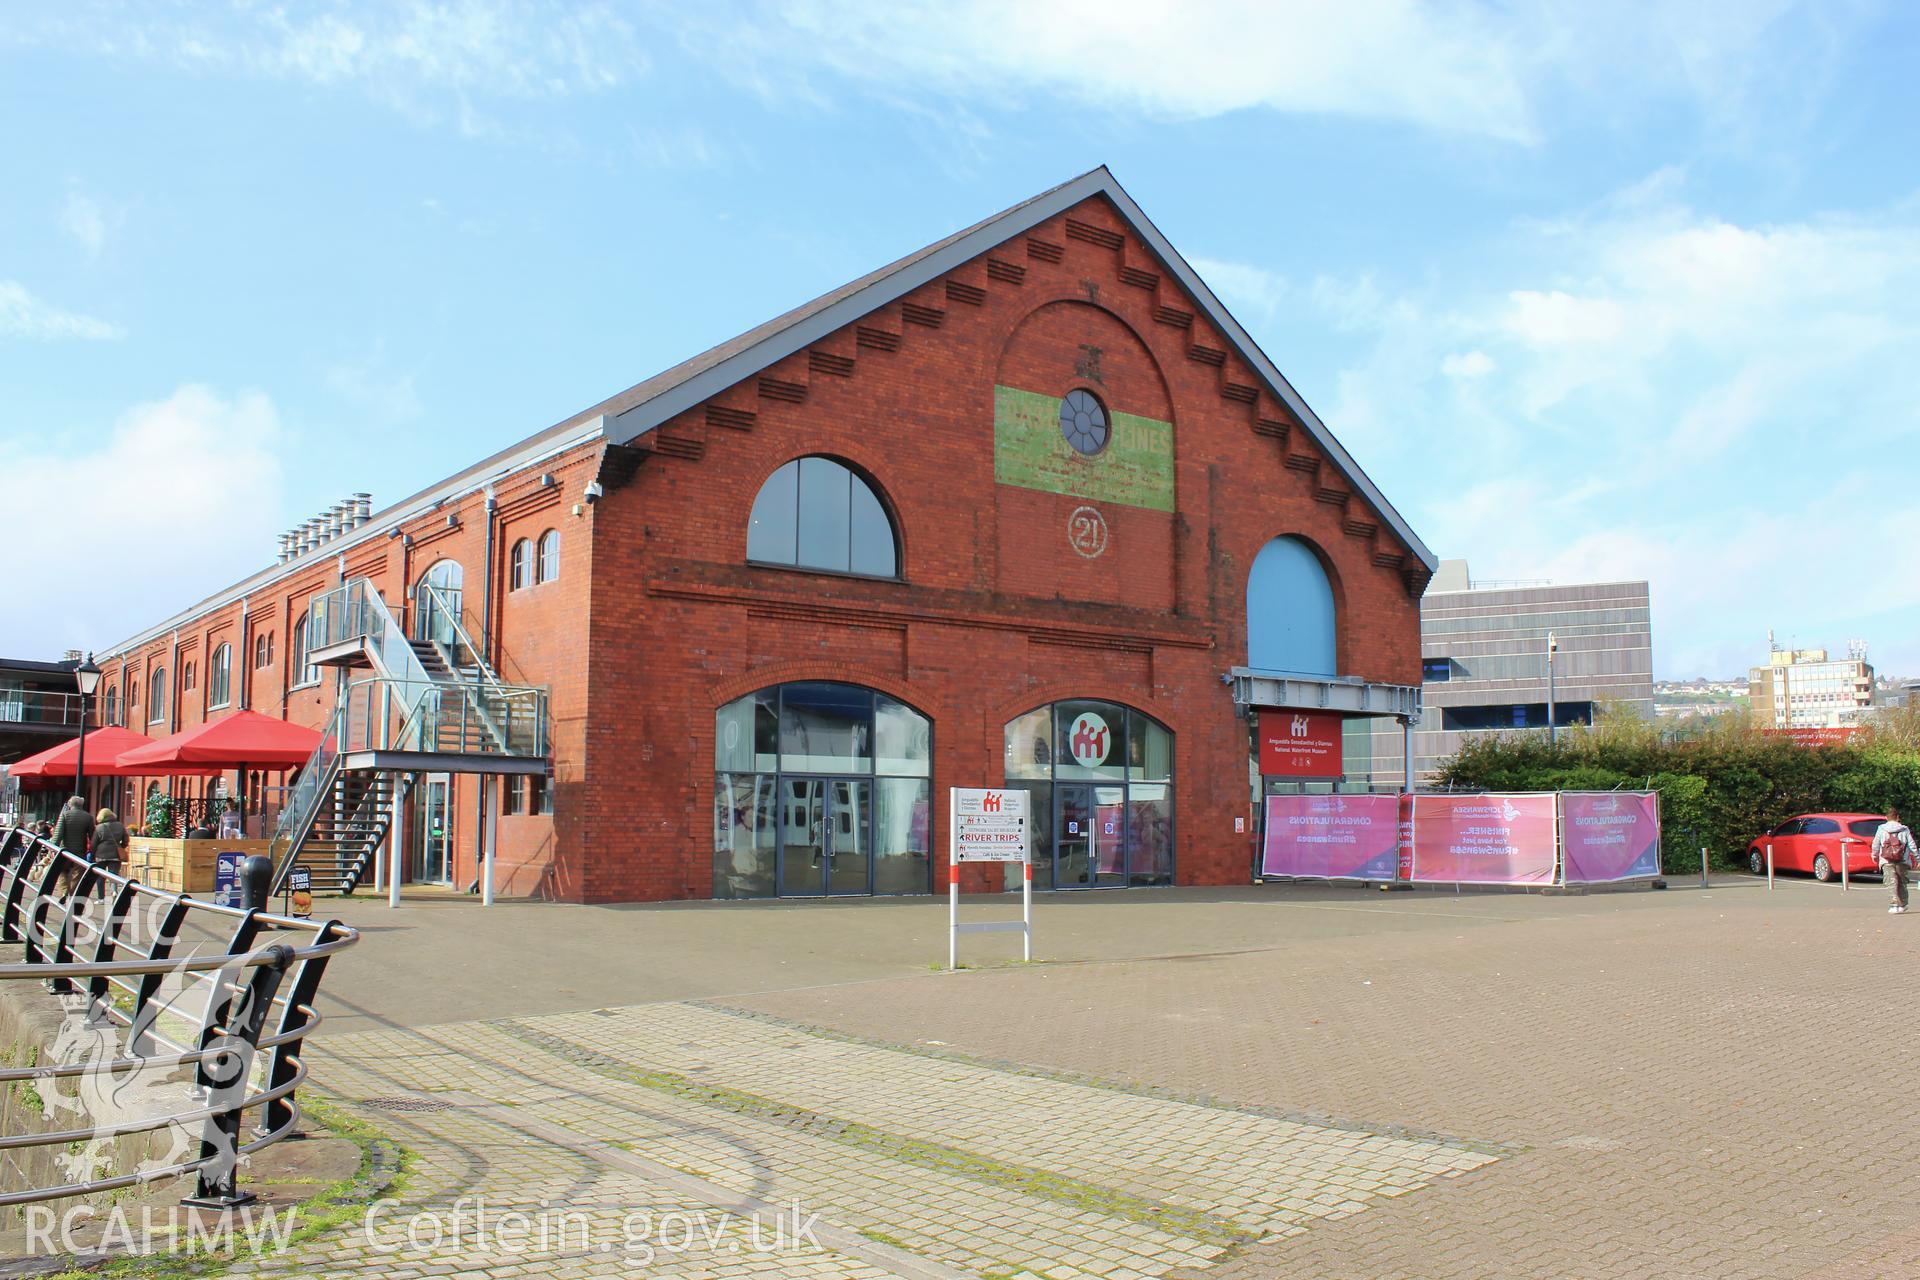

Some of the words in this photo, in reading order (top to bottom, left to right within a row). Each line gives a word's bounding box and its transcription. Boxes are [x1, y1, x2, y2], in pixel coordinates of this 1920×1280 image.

[1119, 420, 1171, 456] LINES
[1075, 517, 1099, 547] 21
[965, 834, 992, 842] RIVER
[995, 834, 1020, 842] TRIPS
[291, 873, 309, 883] FISH
[295, 882, 309, 890] CHIPS
